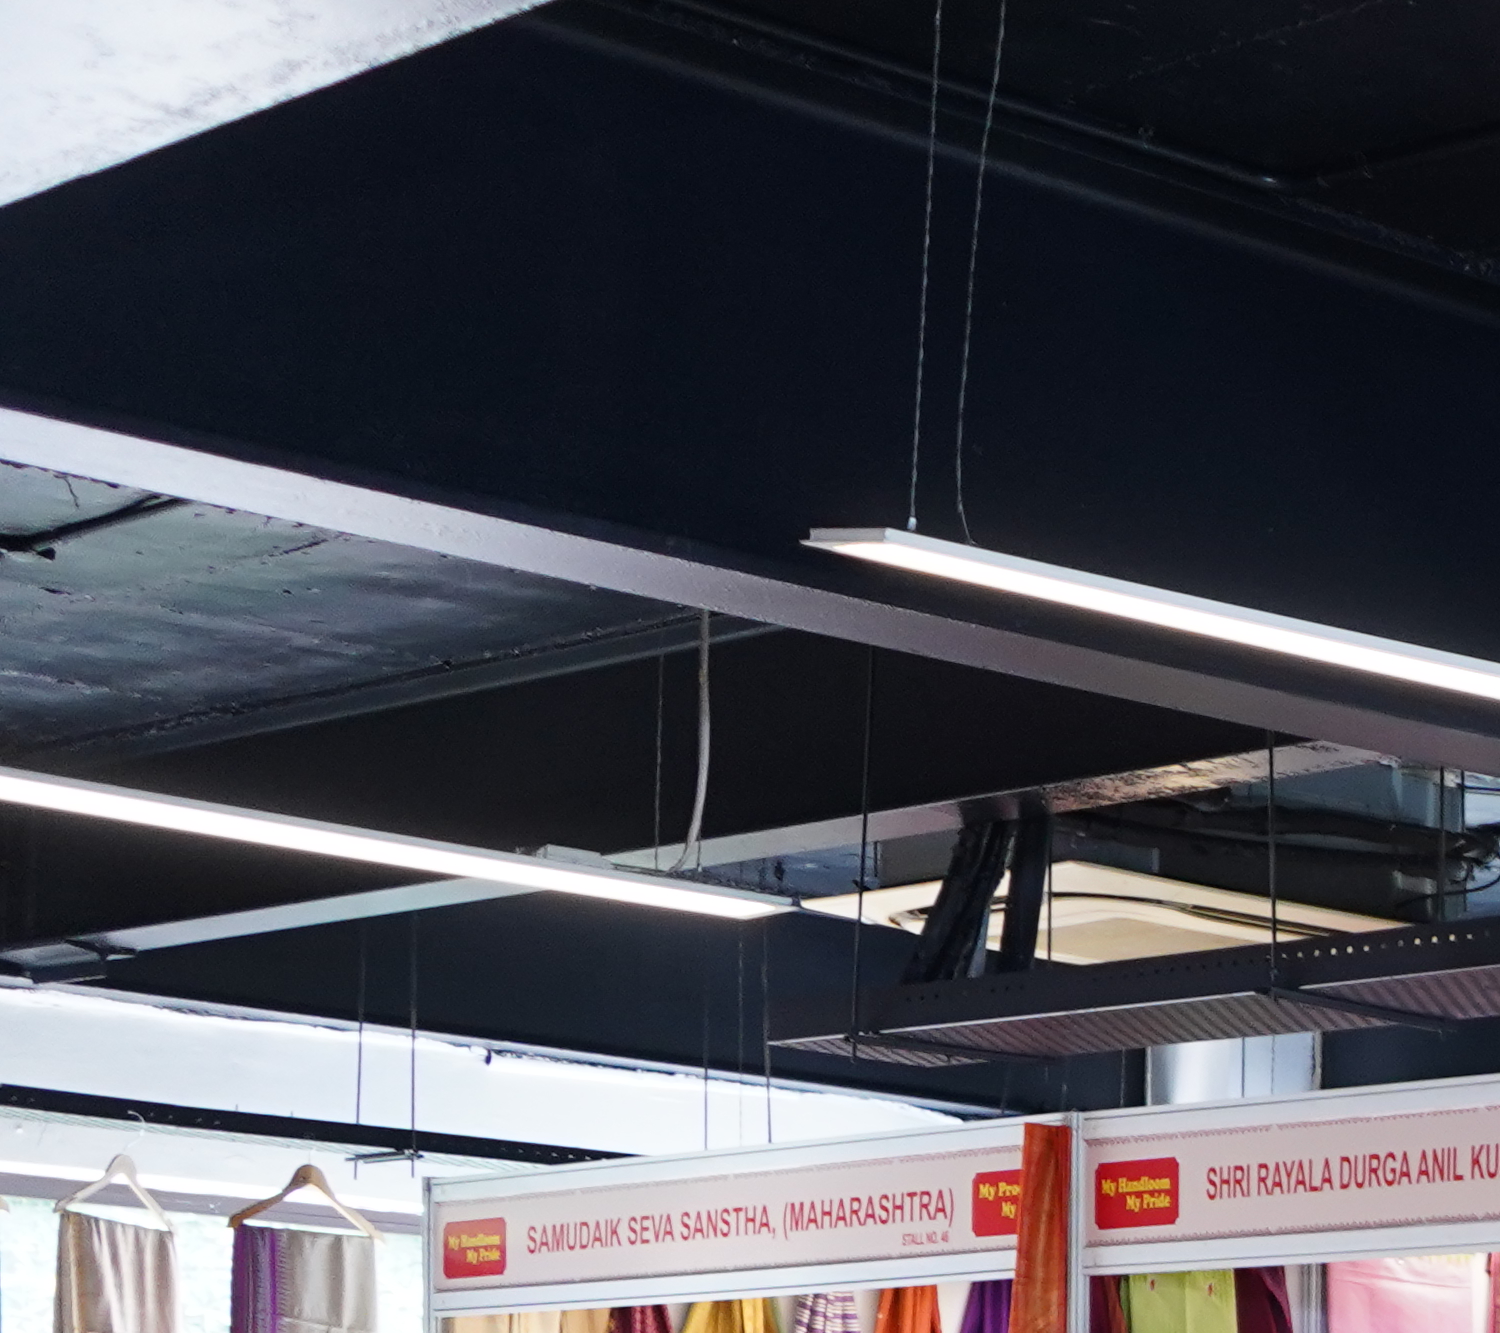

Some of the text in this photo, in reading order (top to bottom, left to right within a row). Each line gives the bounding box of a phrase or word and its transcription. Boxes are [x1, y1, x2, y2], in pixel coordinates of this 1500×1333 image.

[1206, 1164, 1251, 1201] SHRI
[1257, 1157, 1334, 1196] RAYALA
[1339, 1151, 1412, 1190] DURGA
[1416, 1146, 1464, 1184] ANIL
[978, 1183, 997, 1201] My
[1101, 1176, 1171, 1197] My Handloom
[1001, 1201, 1018, 1220] My
[1126, 1192, 1171, 1213] My Pride
[527, 1188, 955, 1254] SAMUDAIK SEVA SANSTHA, (MAHARASHTRA)
